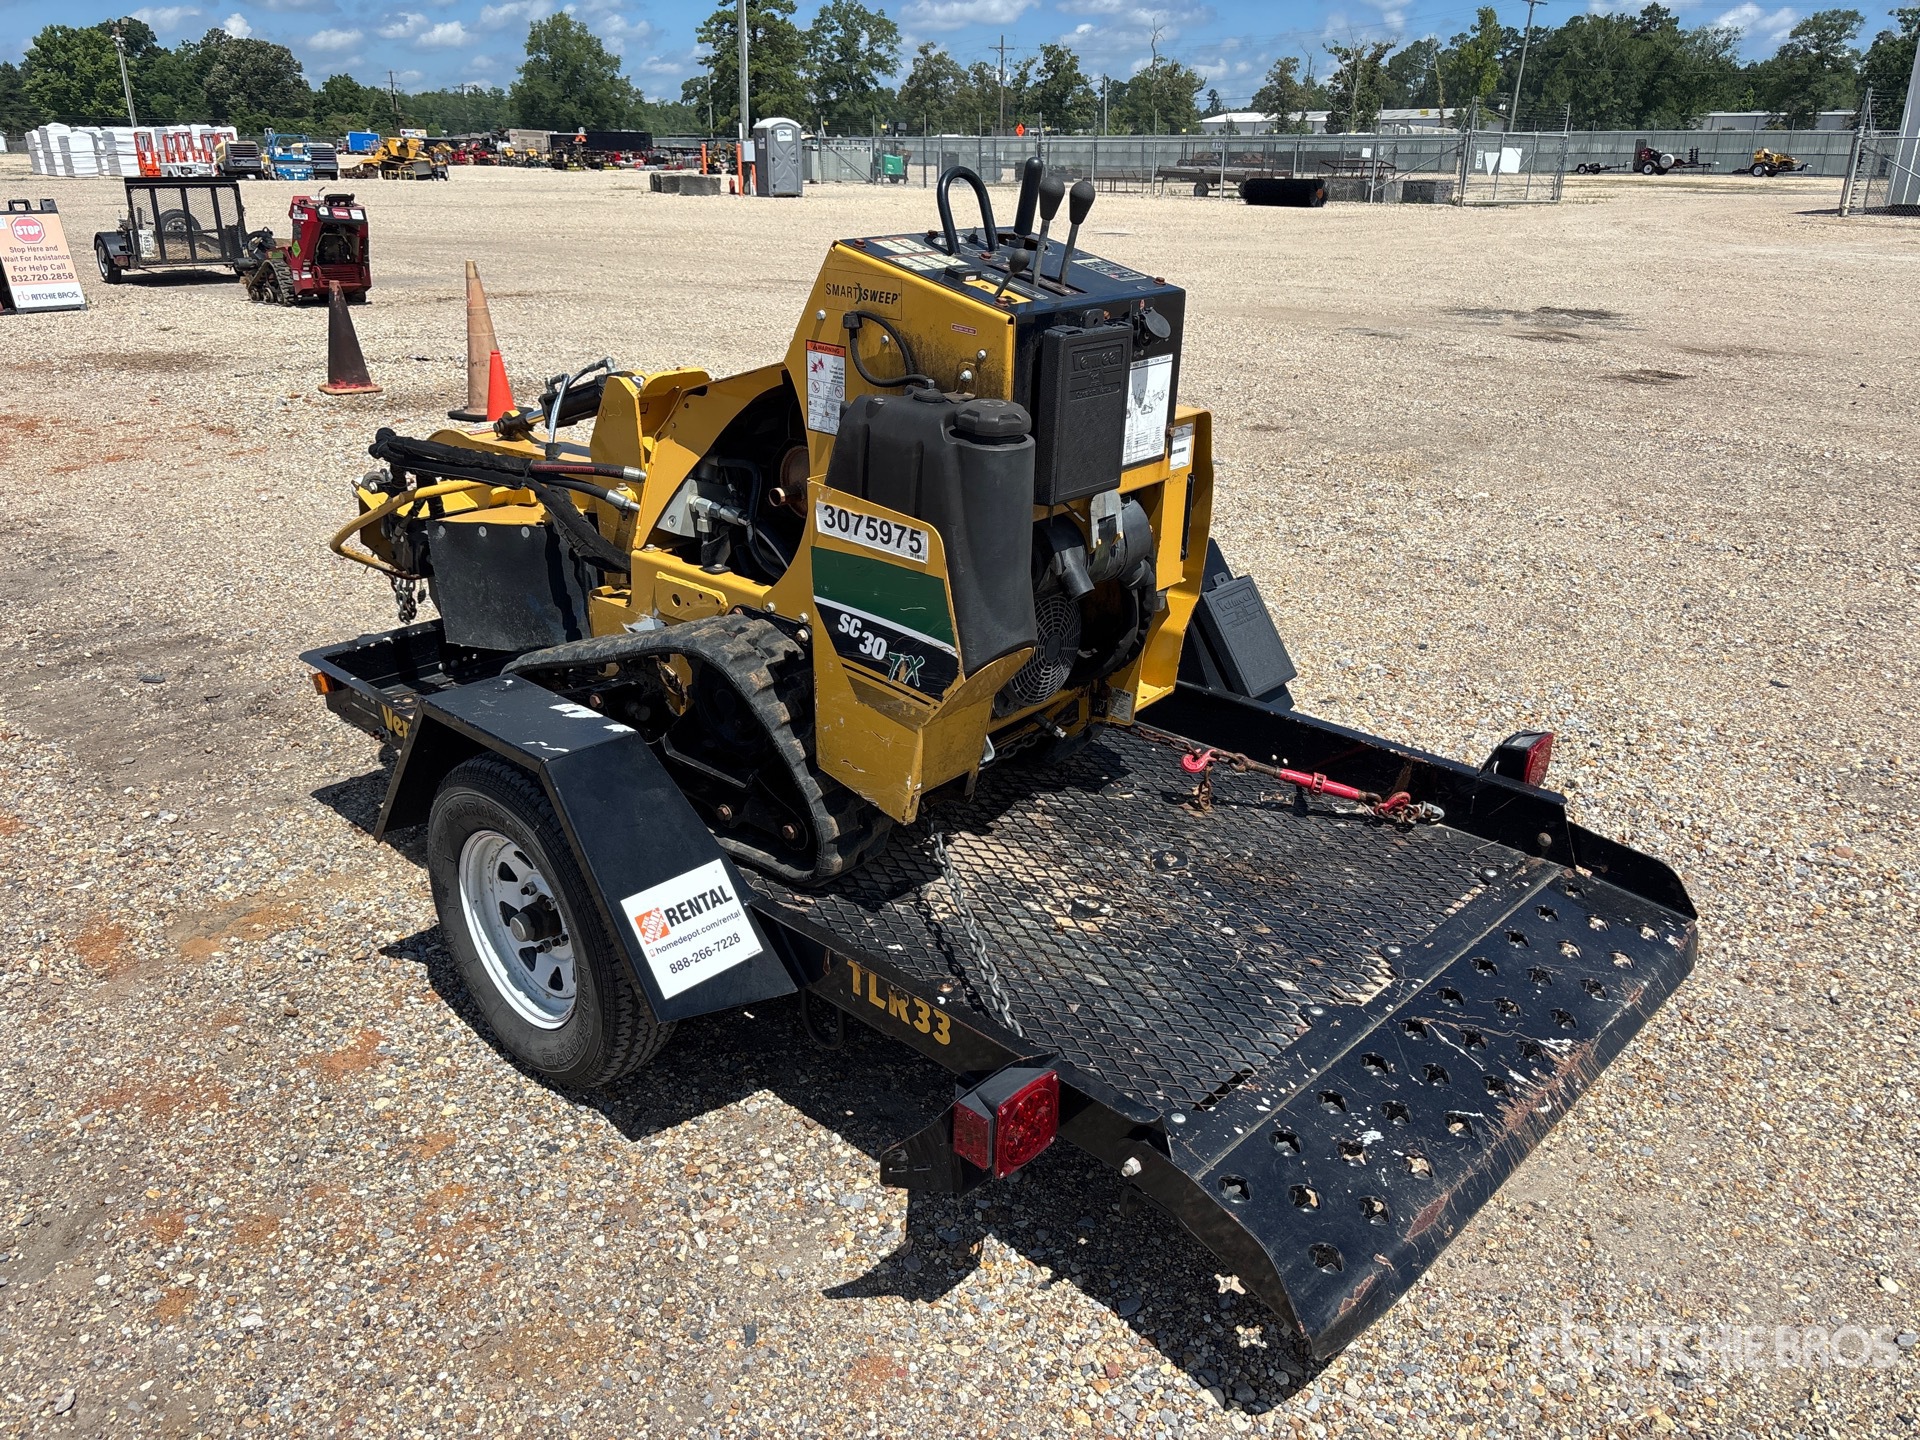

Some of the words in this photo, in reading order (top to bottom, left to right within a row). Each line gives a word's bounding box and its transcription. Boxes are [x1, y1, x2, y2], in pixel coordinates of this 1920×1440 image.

[15, 225, 40, 236] STOP
[9, 246, 26, 254] Stop
[10, 272, 75, 283] 832.720.2858
[28, 264, 49, 272] Help
[50, 262, 67, 270] Call
[31, 293, 57, 301] RITCHIE
[825, 282, 858, 299] SMART
[862, 288, 899, 305] SWEEP
[823, 504, 922, 554] 3075975
[837, 613, 862, 638] SC
[859, 631, 887, 660] 30
[888, 651, 925, 687] TX
[664, 885, 734, 928] RENTAL
[655, 910, 742, 956] homedepot.com/rental
[669, 932, 741, 974] 888-266-7228
[847, 960, 951, 1046] TLR33
